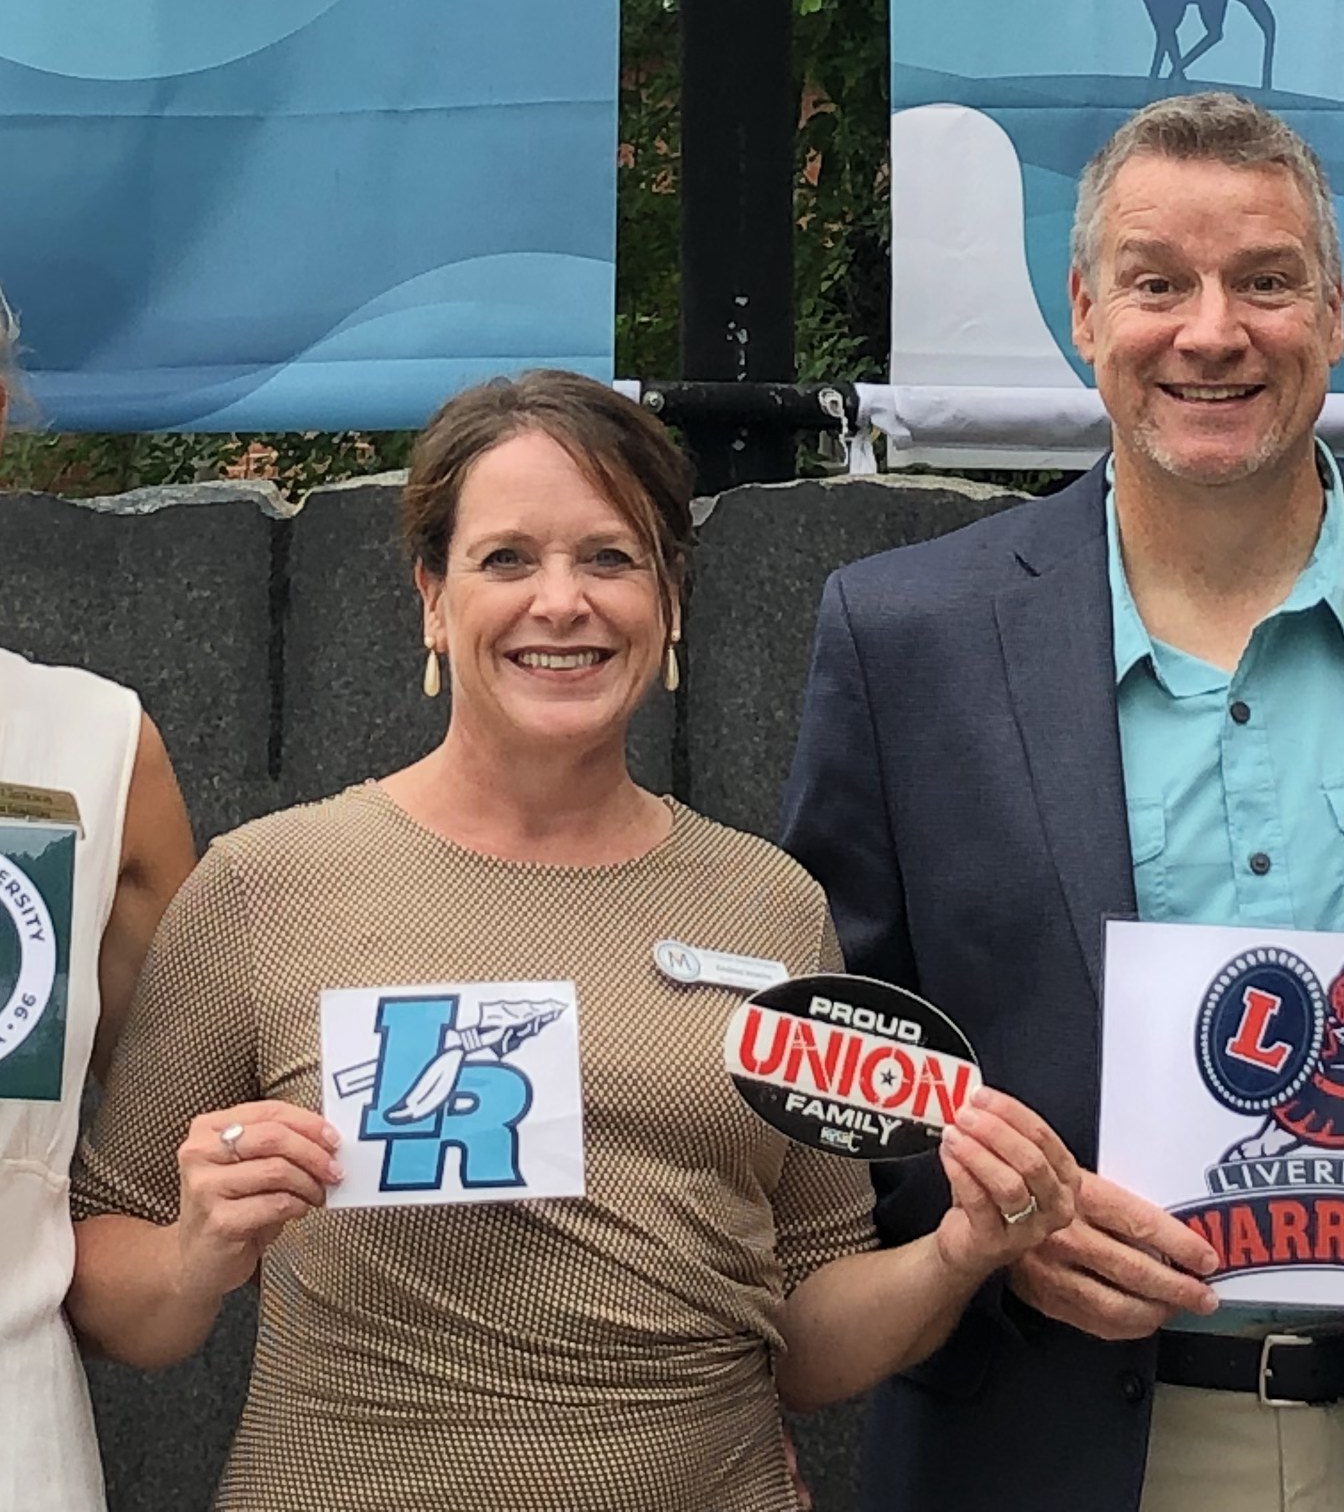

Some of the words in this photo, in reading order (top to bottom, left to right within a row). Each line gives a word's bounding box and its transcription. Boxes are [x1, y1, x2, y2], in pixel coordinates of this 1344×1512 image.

[13, 991, 38, 1021] 96
[808, 995, 923, 1042] PROUD
[1224, 984, 1293, 1075] L
[739, 1006, 971, 1126] UNION
[784, 1091, 903, 1146] FAMILY
